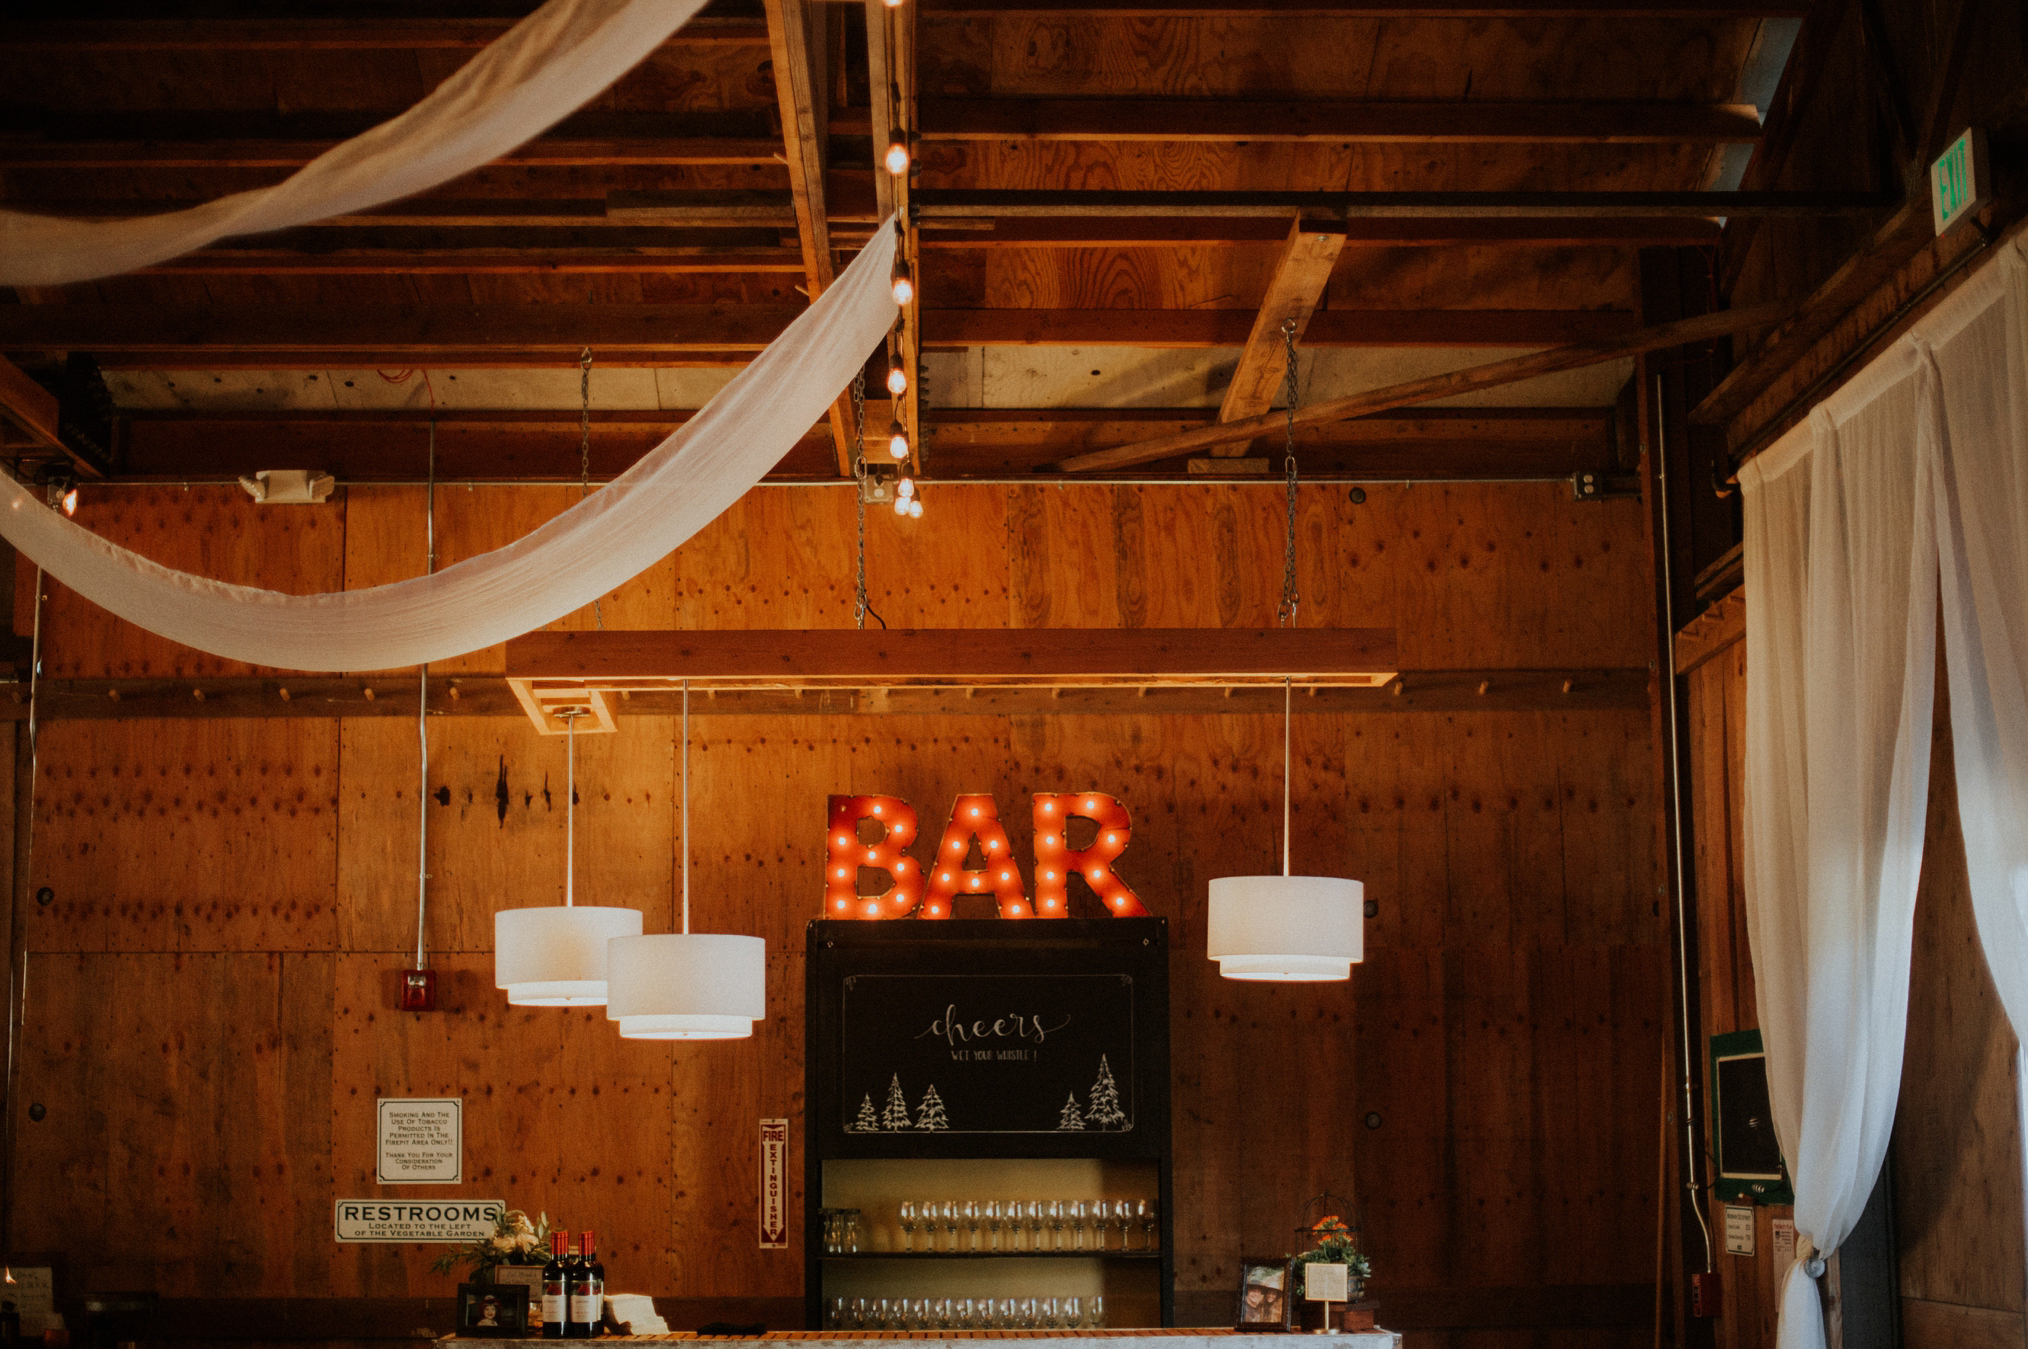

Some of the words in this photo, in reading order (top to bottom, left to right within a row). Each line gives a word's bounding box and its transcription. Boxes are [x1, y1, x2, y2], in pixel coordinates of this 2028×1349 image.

[1938, 138, 1967, 221] EXIT
[823, 791, 1153, 920] BAR
[914, 1003, 1072, 1046] cheers
[951, 1050, 970, 1061] WET
[973, 1050, 993, 1061] YOUR
[996, 1050, 1029, 1061] WHISTLE
[763, 1130, 784, 1142] FIRE
[770, 1144, 778, 1236] EXTINGUISHER
[344, 1206, 497, 1221] RESTROOMS
